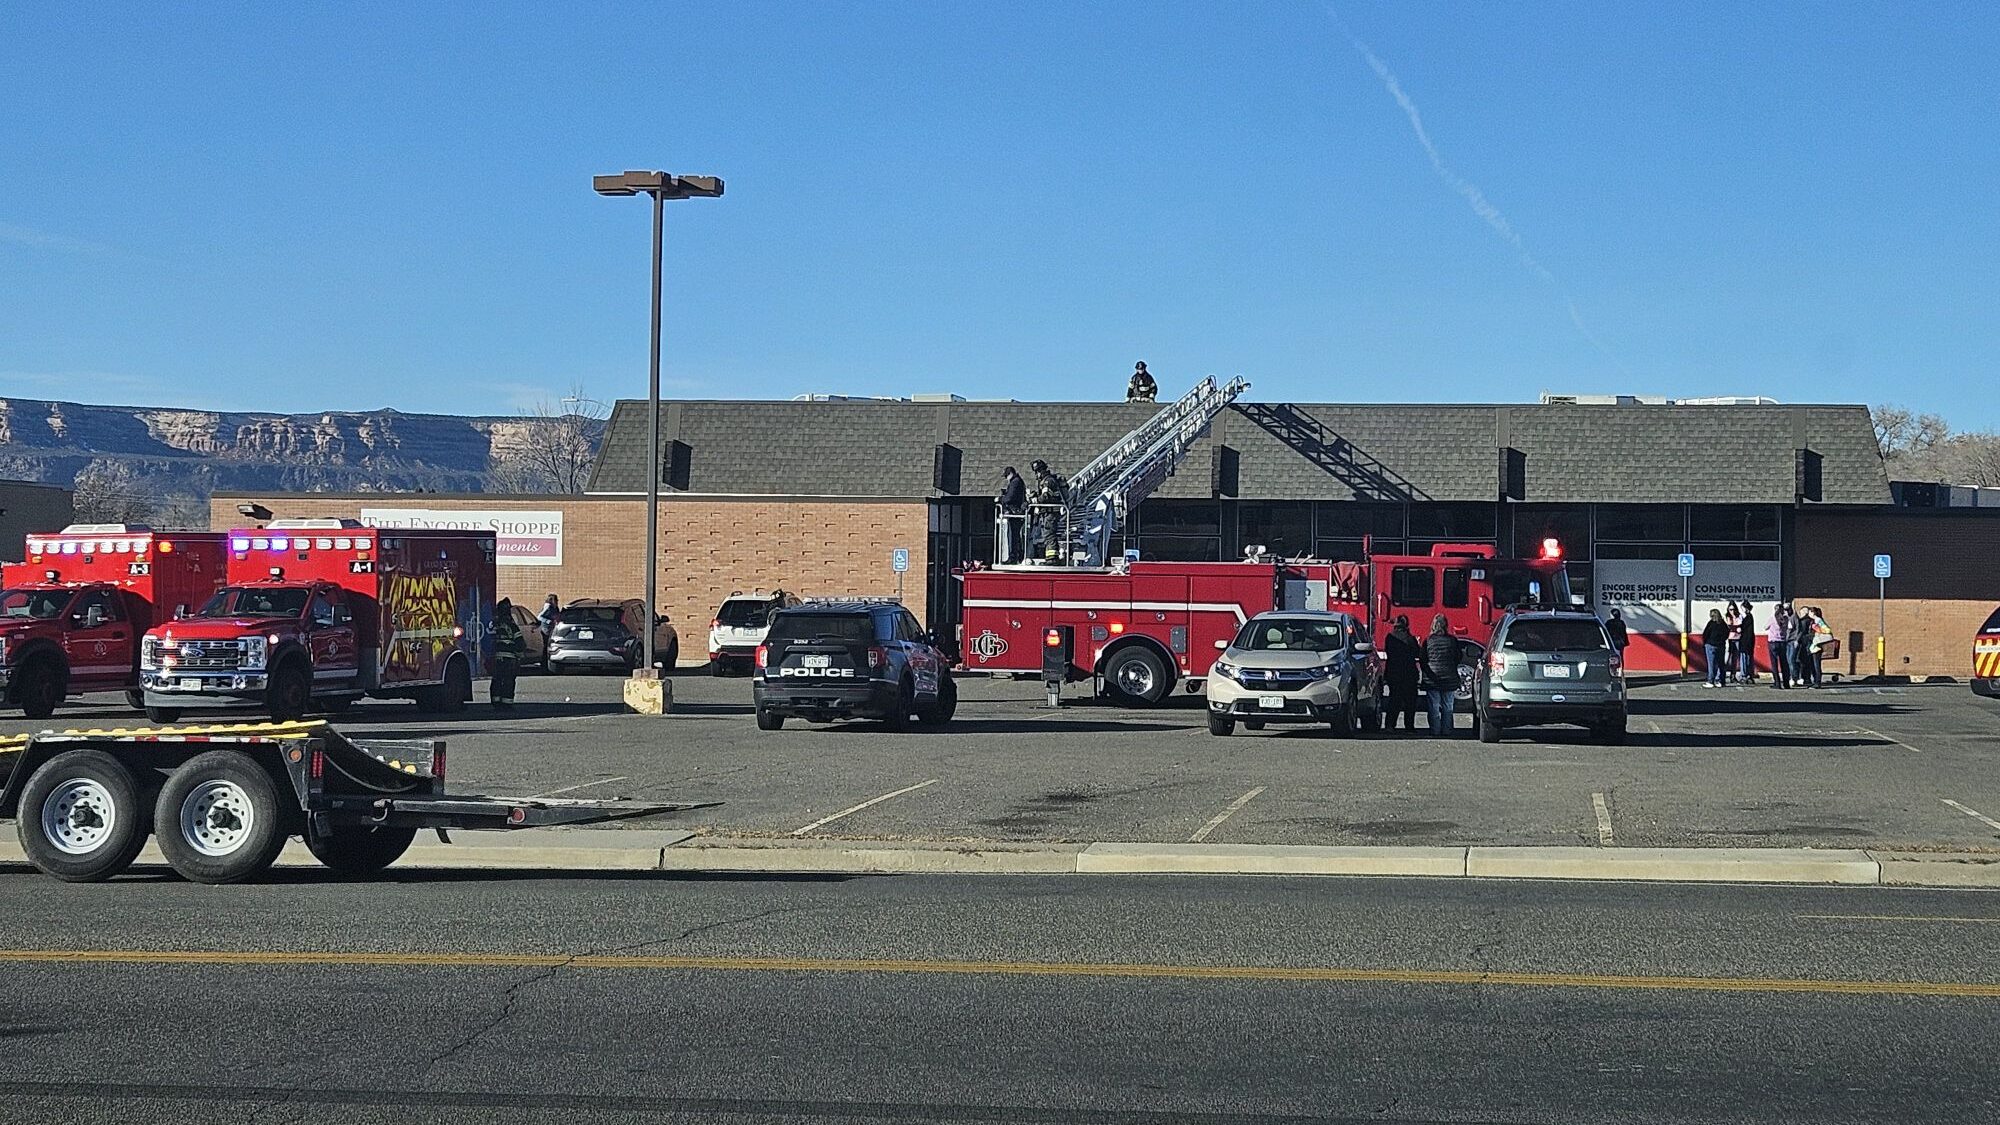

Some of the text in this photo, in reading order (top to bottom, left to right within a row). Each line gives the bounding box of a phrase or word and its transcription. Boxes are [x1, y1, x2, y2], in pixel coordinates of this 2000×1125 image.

[489, 518, 560, 535] SHOPPE
[130, 563, 149, 574] A-3
[352, 562, 372, 573] A-1
[1601, 584, 1677, 592] ENCORE SHOPPE'S
[1695, 585, 1776, 594] CONSIGNMENTS
[1601, 592, 1677, 601] STORE HOURS
[780, 667, 855, 677] POLICE
